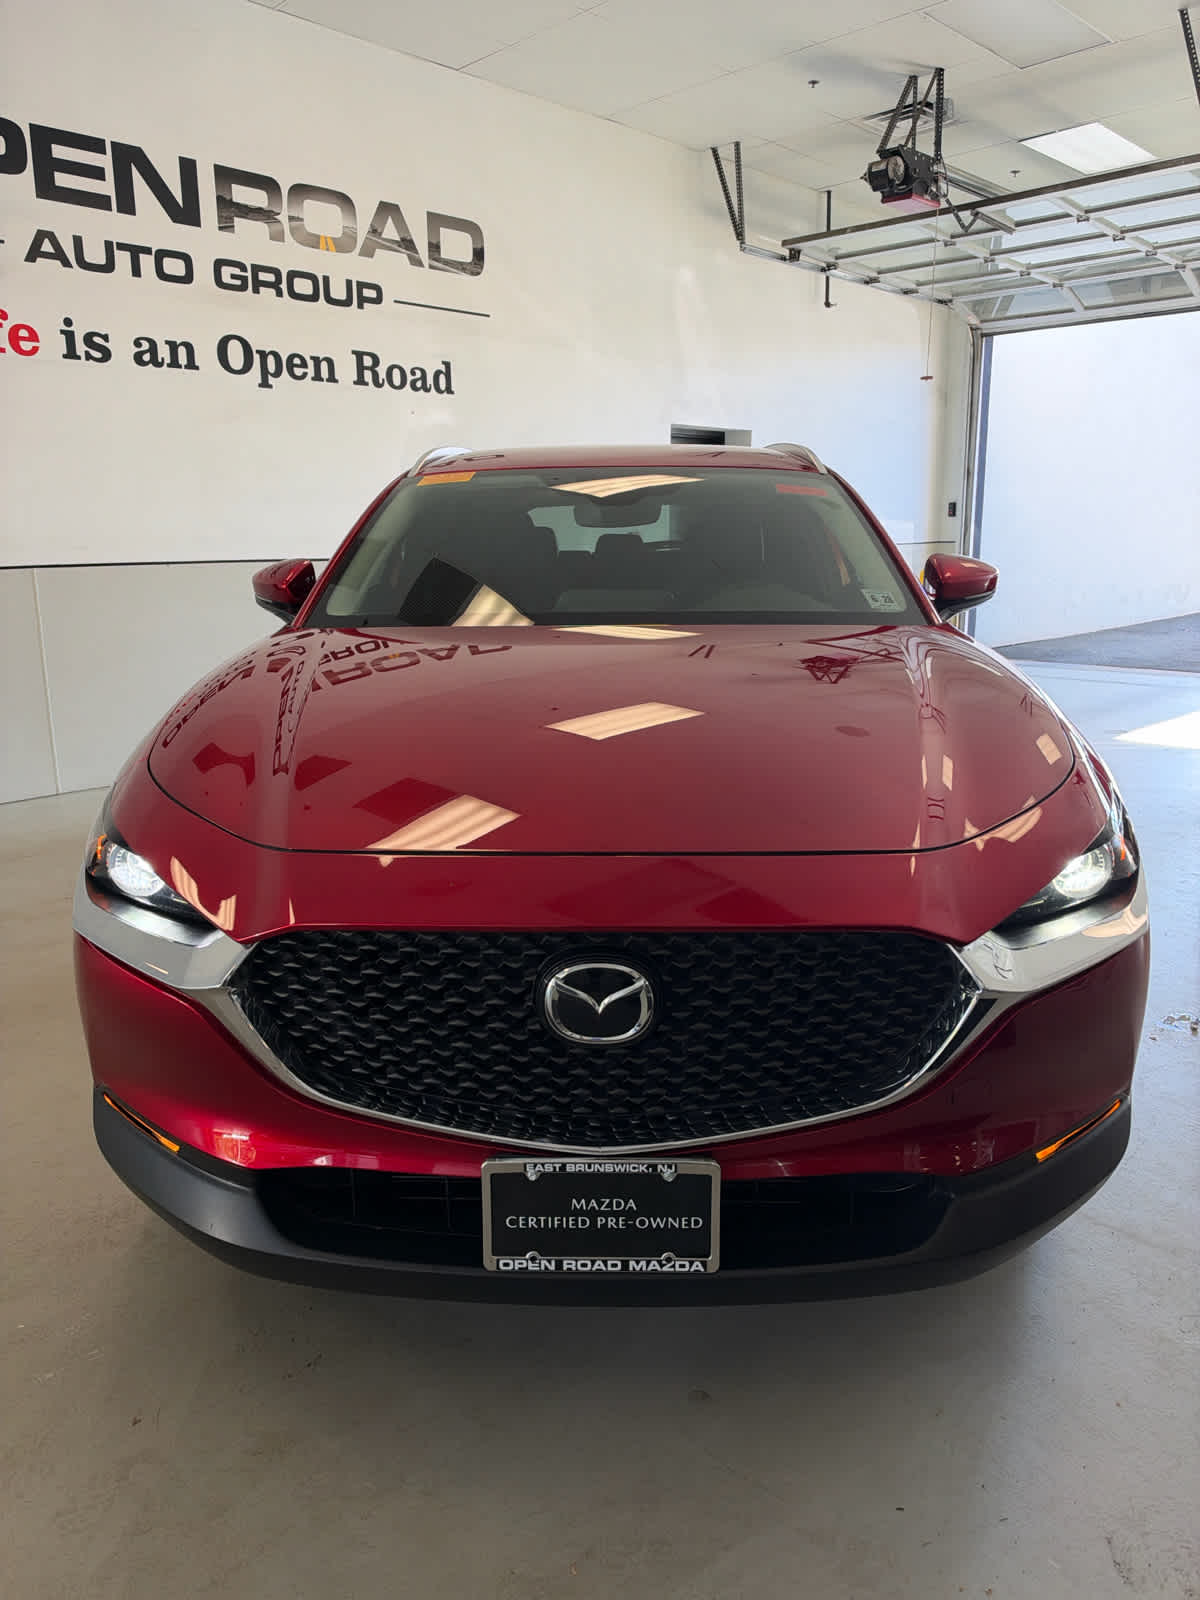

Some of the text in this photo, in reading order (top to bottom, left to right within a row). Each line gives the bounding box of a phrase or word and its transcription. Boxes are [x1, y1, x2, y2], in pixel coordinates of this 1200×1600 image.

[213, 163, 485, 277] ROAD
[24, 229, 384, 310] AUTO GROUP
[60, 317, 112, 363] is
[133, 336, 200, 371] an
[216, 333, 339, 389] Open
[352, 350, 455, 395] Road
[526, 1163, 562, 1174] EAST
[657, 1164, 676, 1174] NJ
[571, 1198, 637, 1211] MAZDA
[505, 1216, 703, 1229] CERTIFIED PRE-OWNED
[499, 1259, 705, 1272] OPEN ROAD MAZDA
